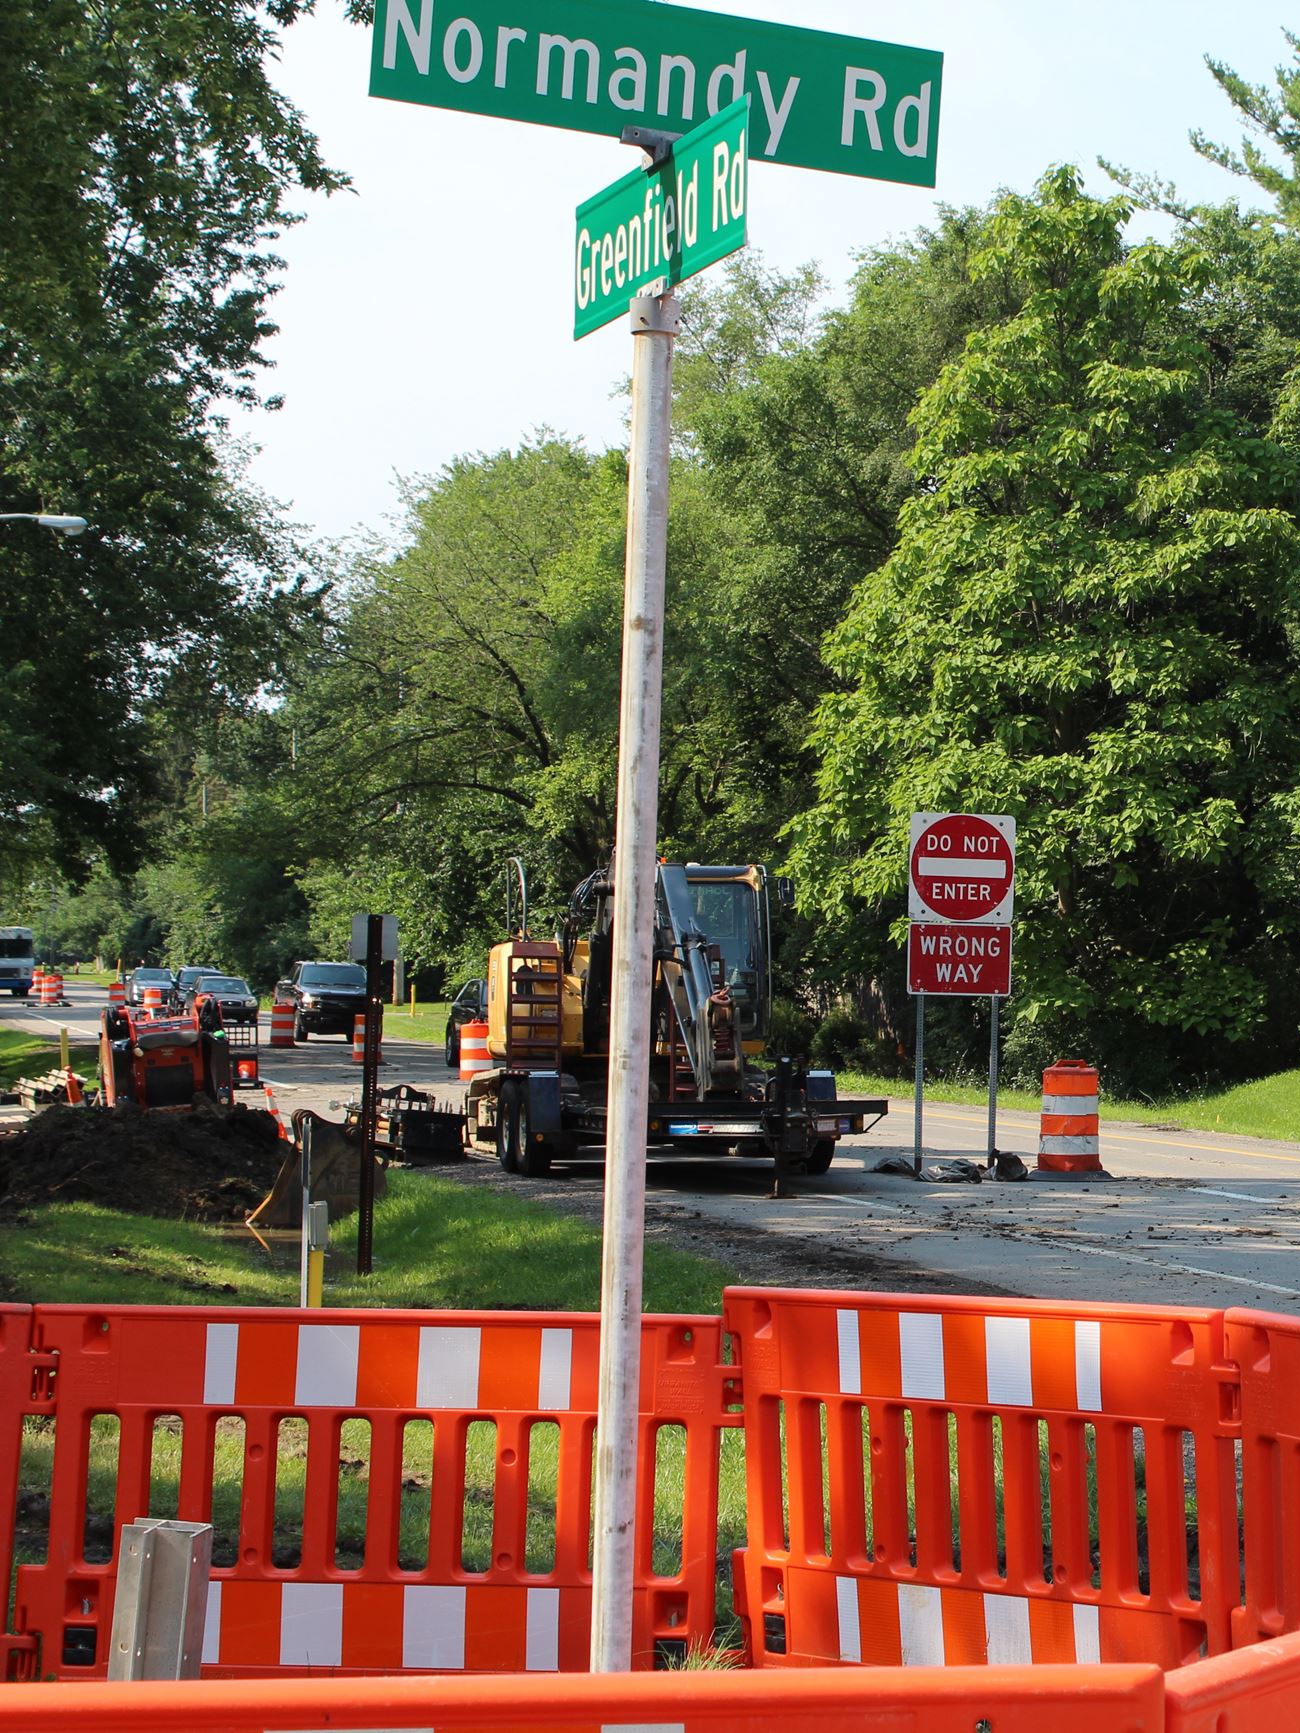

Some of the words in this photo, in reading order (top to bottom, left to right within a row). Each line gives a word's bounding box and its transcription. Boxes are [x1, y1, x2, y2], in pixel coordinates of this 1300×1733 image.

[382, 0, 801, 157] Normandy
[840, 65, 932, 159] Rd
[576, 160, 699, 311] Greenfield
[712, 128, 745, 233] Rd
[927, 834, 951, 851] DO
[964, 836, 1000, 853] NOT
[932, 883, 990, 900] ENTER
[920, 935, 1001, 957] WRONG
[936, 963, 983, 984] WAY
